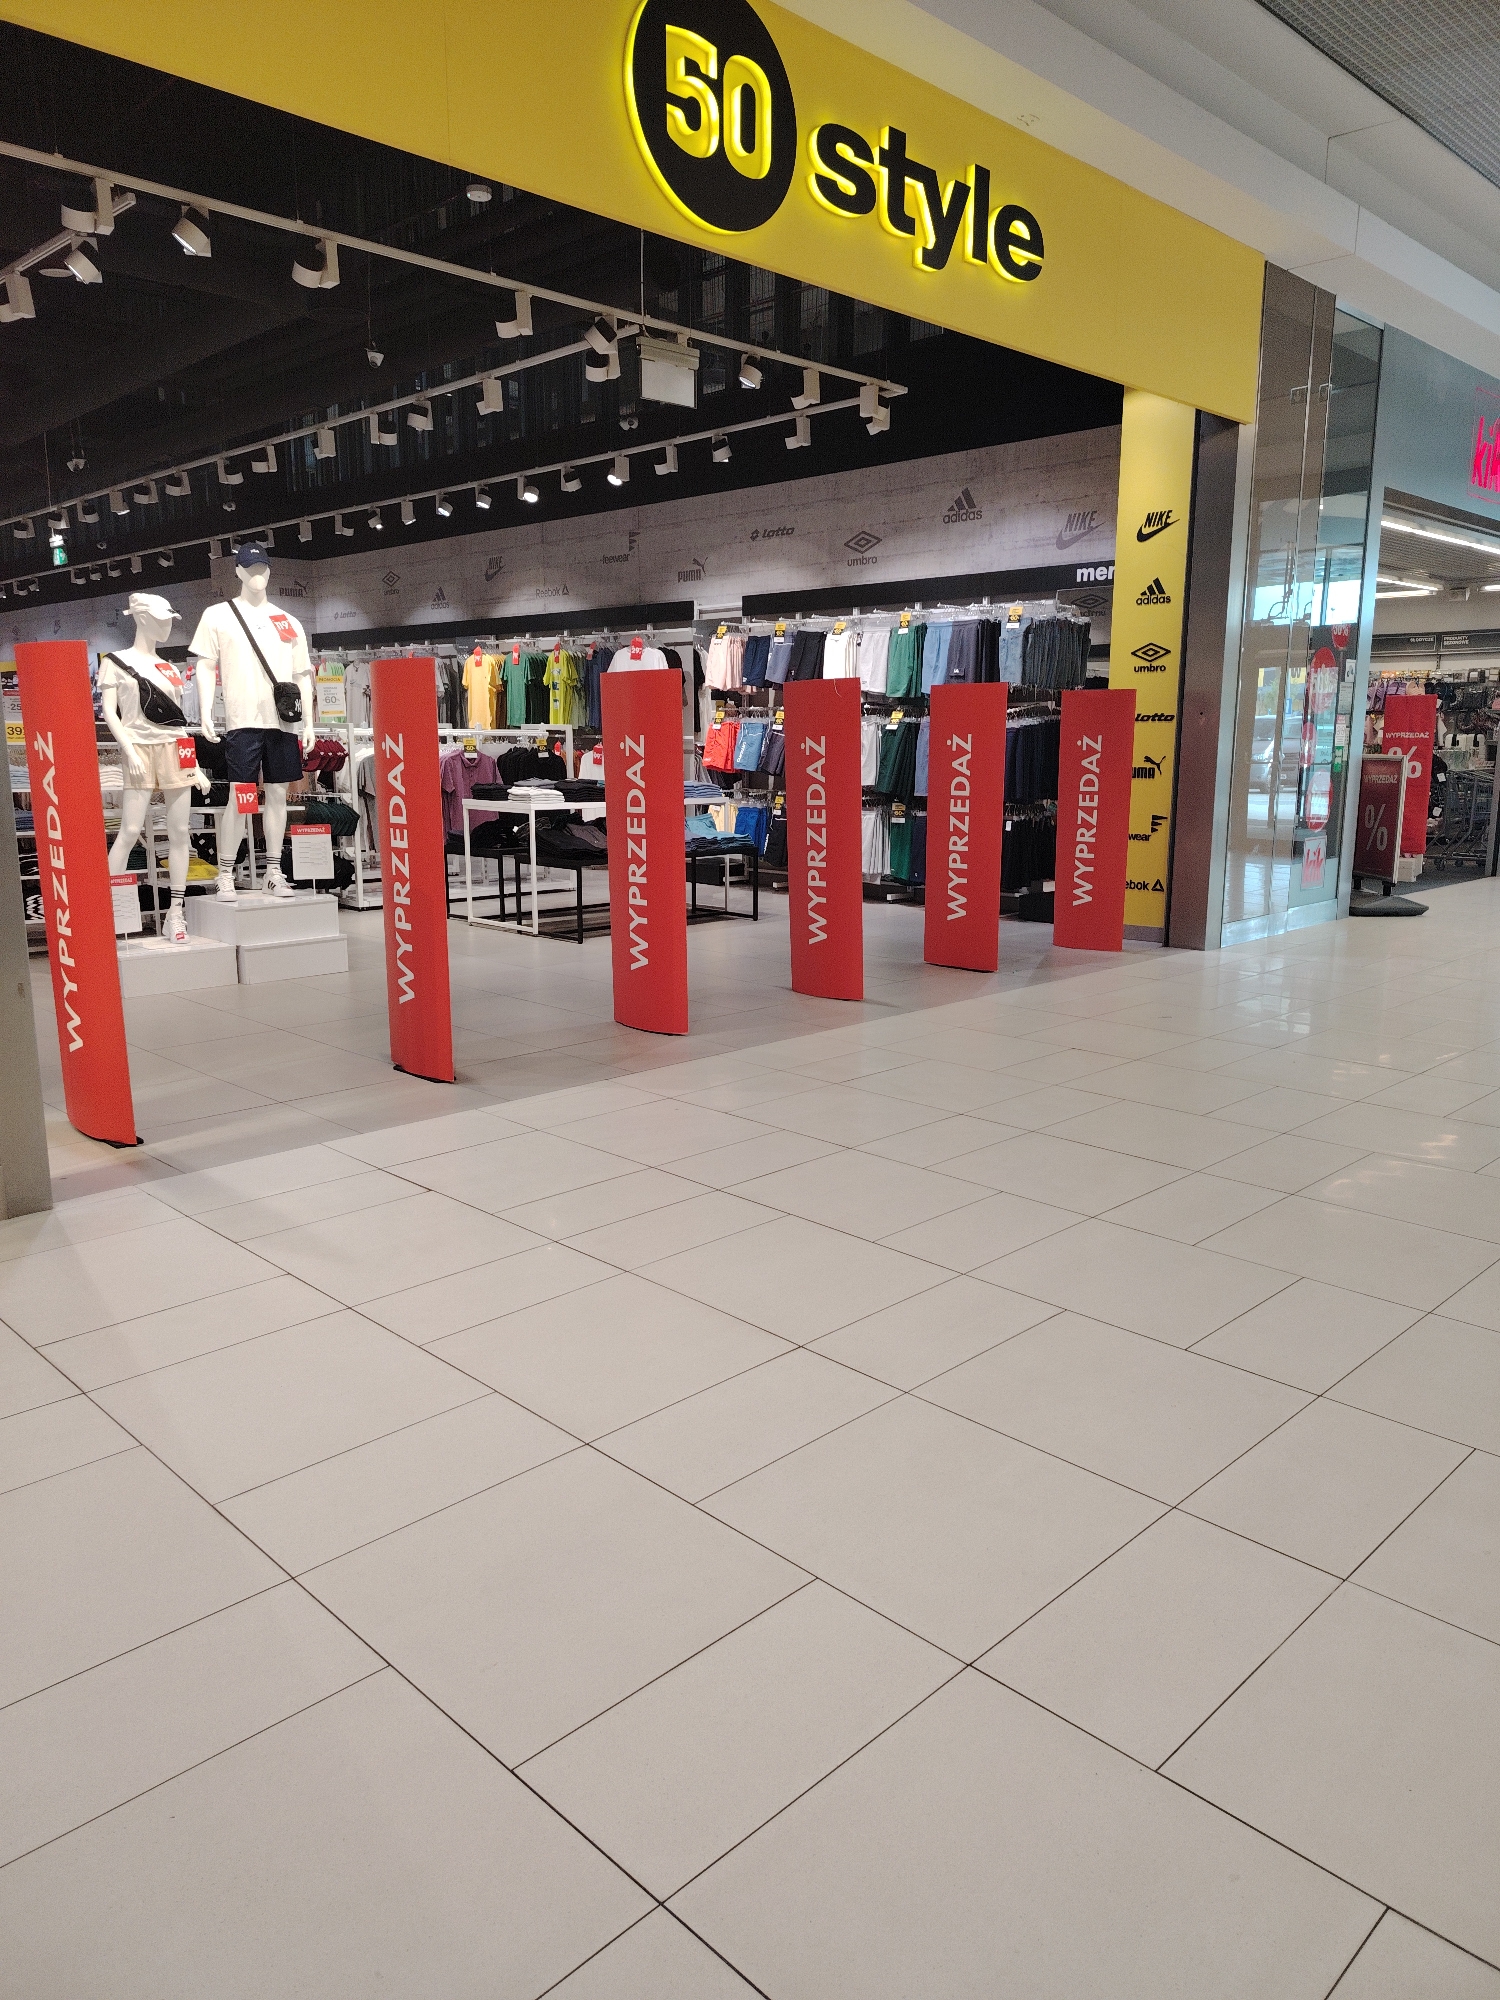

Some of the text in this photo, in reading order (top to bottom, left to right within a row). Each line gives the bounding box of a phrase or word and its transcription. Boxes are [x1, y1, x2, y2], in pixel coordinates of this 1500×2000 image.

[665, 24, 1045, 283] 50 style
[942, 509, 983, 524] adidas
[1064, 510, 1098, 532] NIKE
[1143, 509, 1173, 529] NIKE
[847, 556, 878, 567] umbro
[677, 568, 702, 583] PUMA
[535, 587, 561, 599] Reebok
[1135, 595, 1171, 606] adidas
[1134, 664, 1167, 673] umbro
[1385, 731, 1430, 739] WYPRZEDAŻ
[1131, 767, 1155, 778] UMA
[1363, 774, 1398, 784] WYPRZEDAŻ
[946, 733, 972, 921] WYPRZEDAŻ
[1071, 734, 1103, 907] WYPRZEDAŻ
[800, 735, 828, 945] WYPRZEDAŻ
[1128, 833, 1151, 841] wear
[619, 734, 649, 971] WYPRZEDAŻ
[381, 732, 415, 1005] WYPRZEDAŻ
[33, 731, 84, 1053] WYPRZEDAŻ
[1125, 880, 1149, 891] ebok
